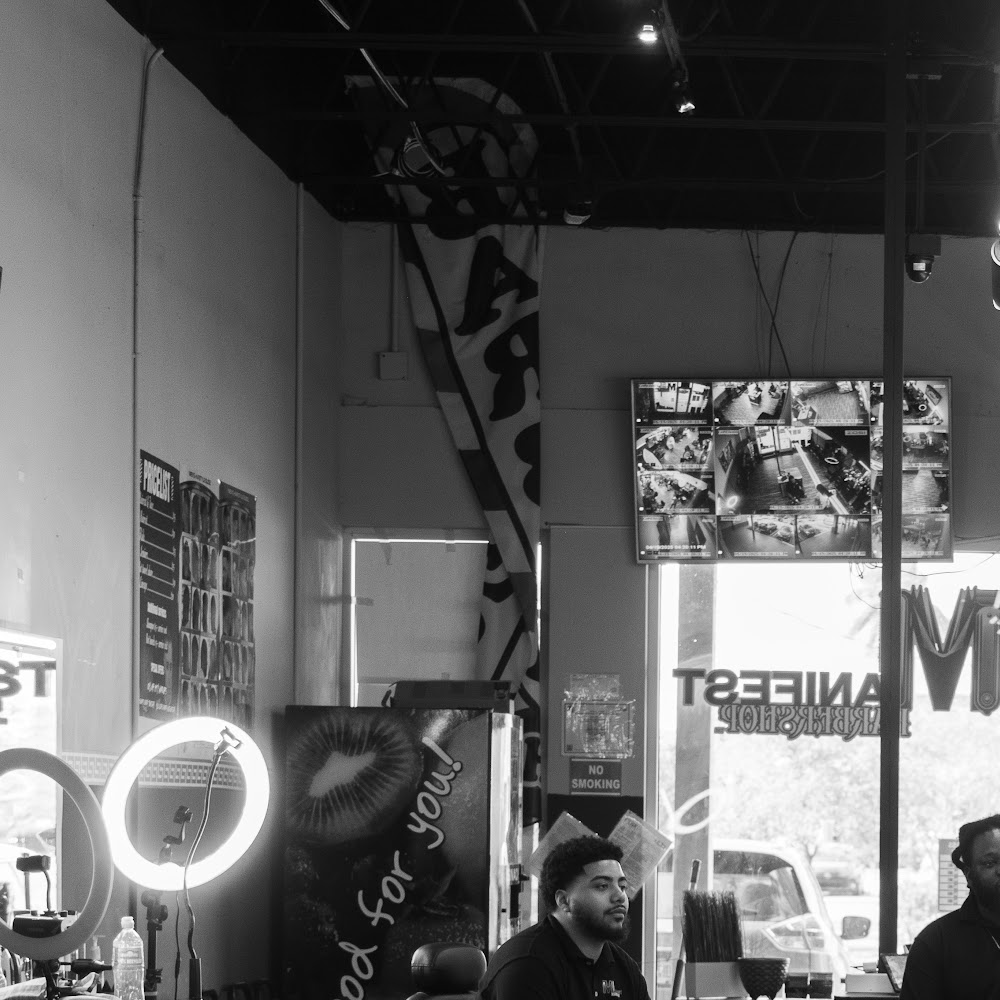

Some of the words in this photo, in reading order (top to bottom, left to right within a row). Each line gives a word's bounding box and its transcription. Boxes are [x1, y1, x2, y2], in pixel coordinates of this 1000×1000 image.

[143, 459, 171, 503] PRICELIST
[588, 765, 603, 775] NO
[571, 779, 621, 790] SMOKING
[358, 850, 413, 926] for
[407, 736, 462, 850] you!
